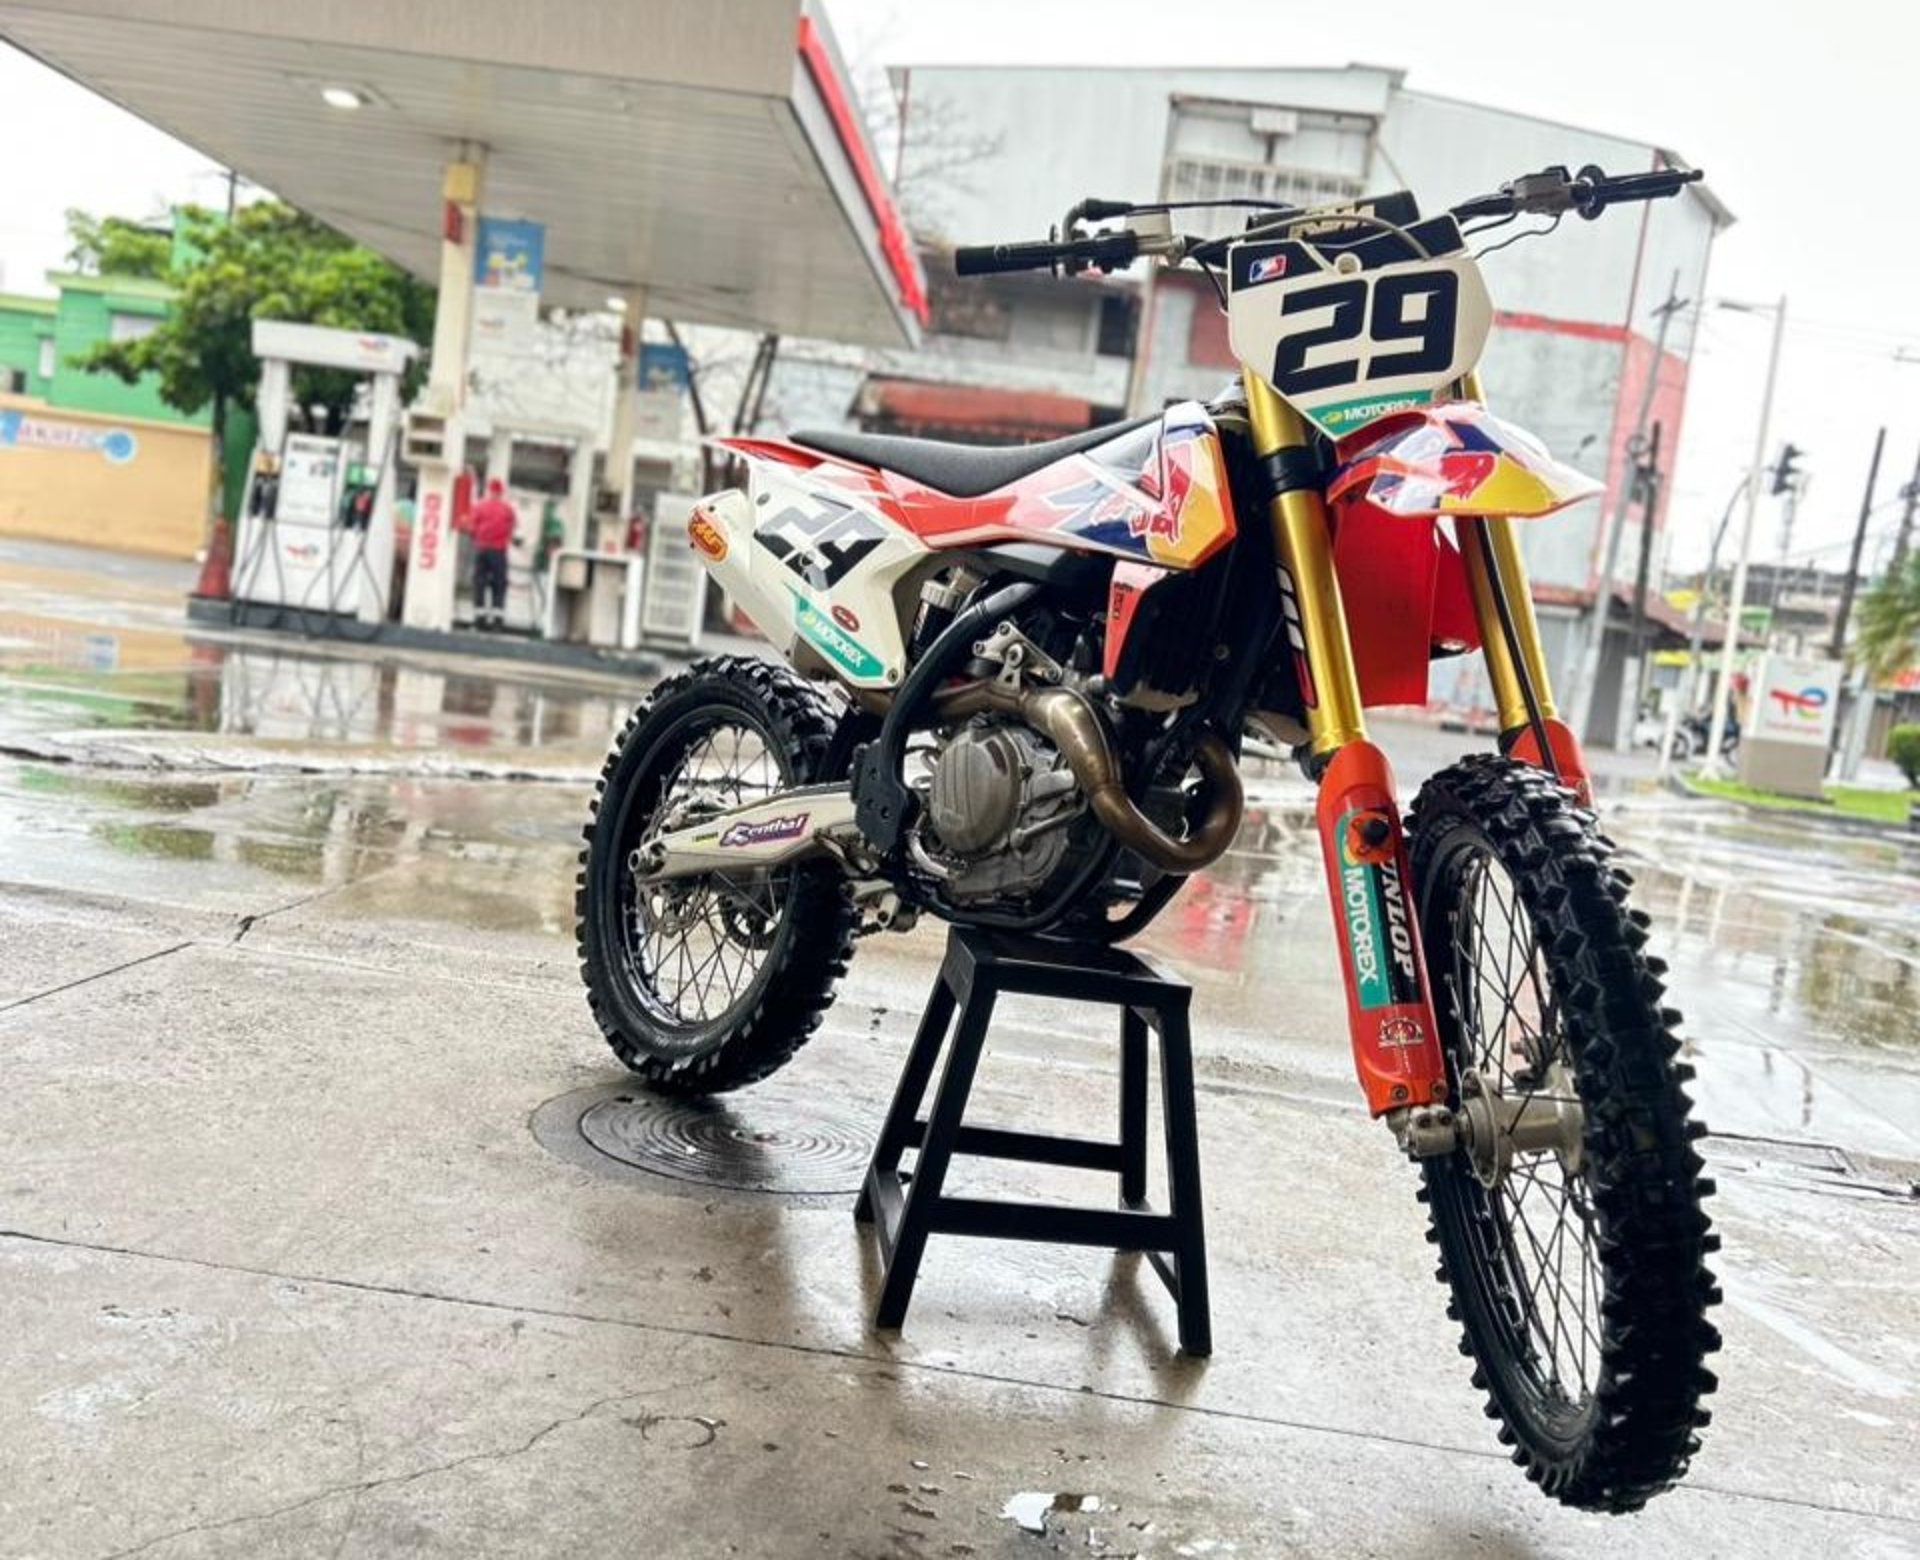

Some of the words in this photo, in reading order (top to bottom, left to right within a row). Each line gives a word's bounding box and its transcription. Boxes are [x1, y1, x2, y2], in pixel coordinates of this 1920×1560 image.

[1272, 269, 1458, 396] 29
[720, 812, 811, 847] Renthal
[1343, 866, 1379, 985] MOTOREX
[1379, 856, 1416, 978] UNLOP
